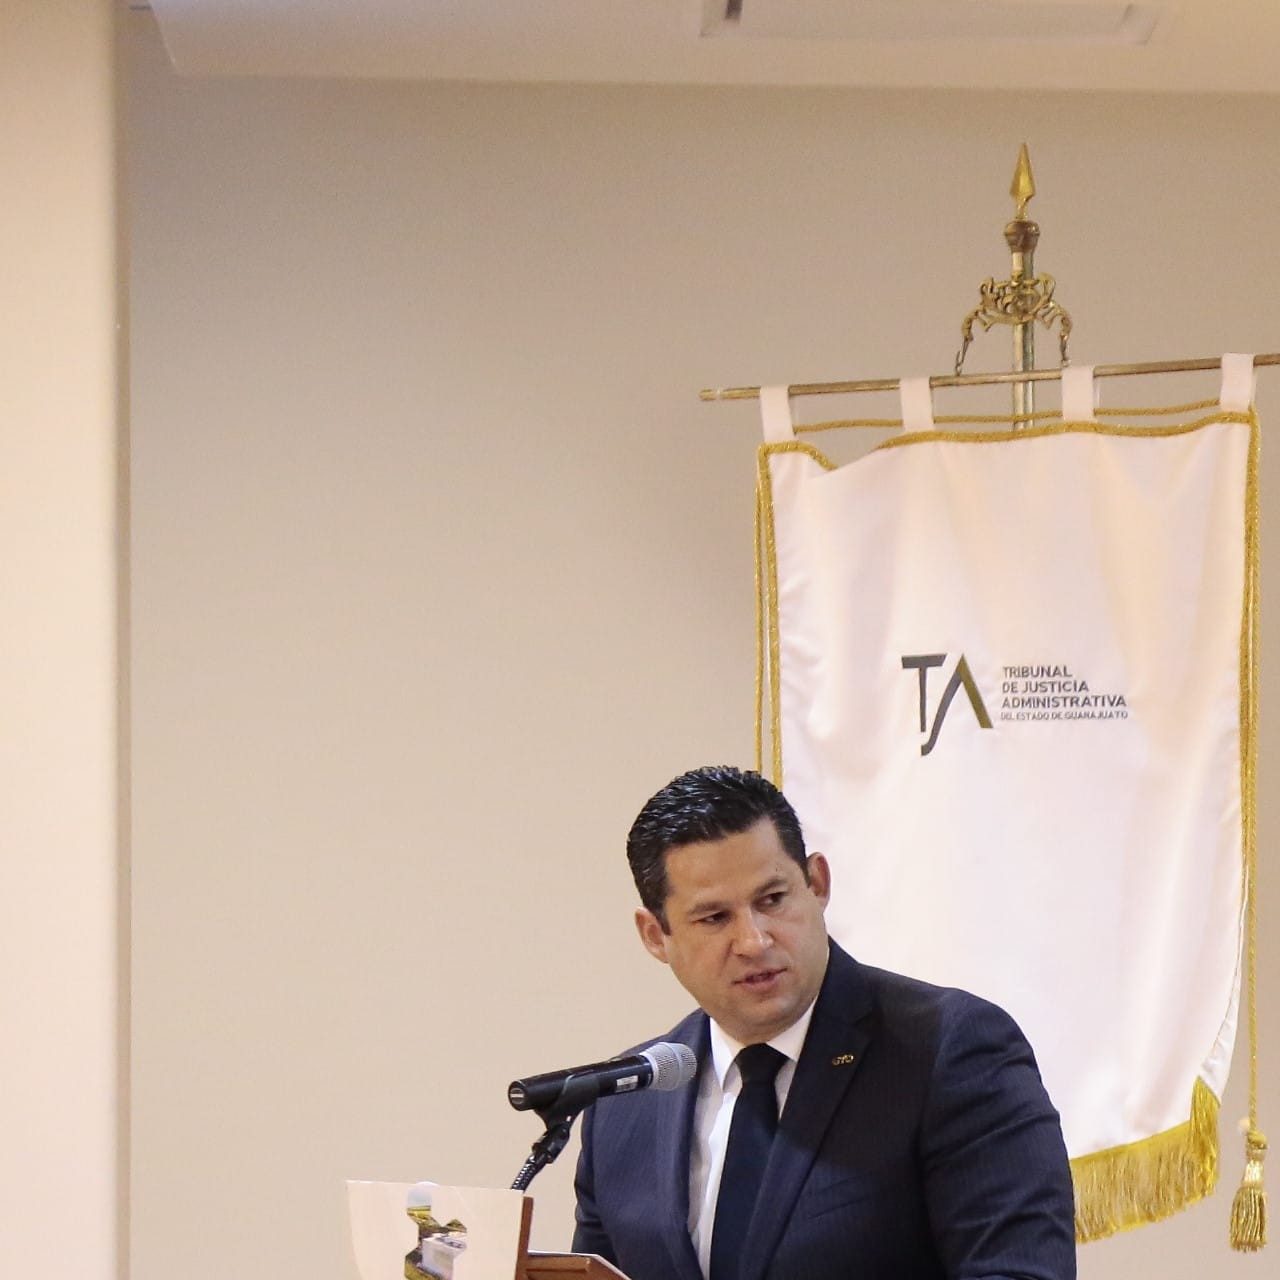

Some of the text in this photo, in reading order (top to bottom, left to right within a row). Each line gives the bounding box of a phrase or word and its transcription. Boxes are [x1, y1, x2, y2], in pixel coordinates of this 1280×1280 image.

[1002, 665, 1073, 679] TRIBUNAL
[1002, 680, 1089, 694] DE JUSTICIA
[1002, 695, 1127, 709] ADMINISTRATIVA
